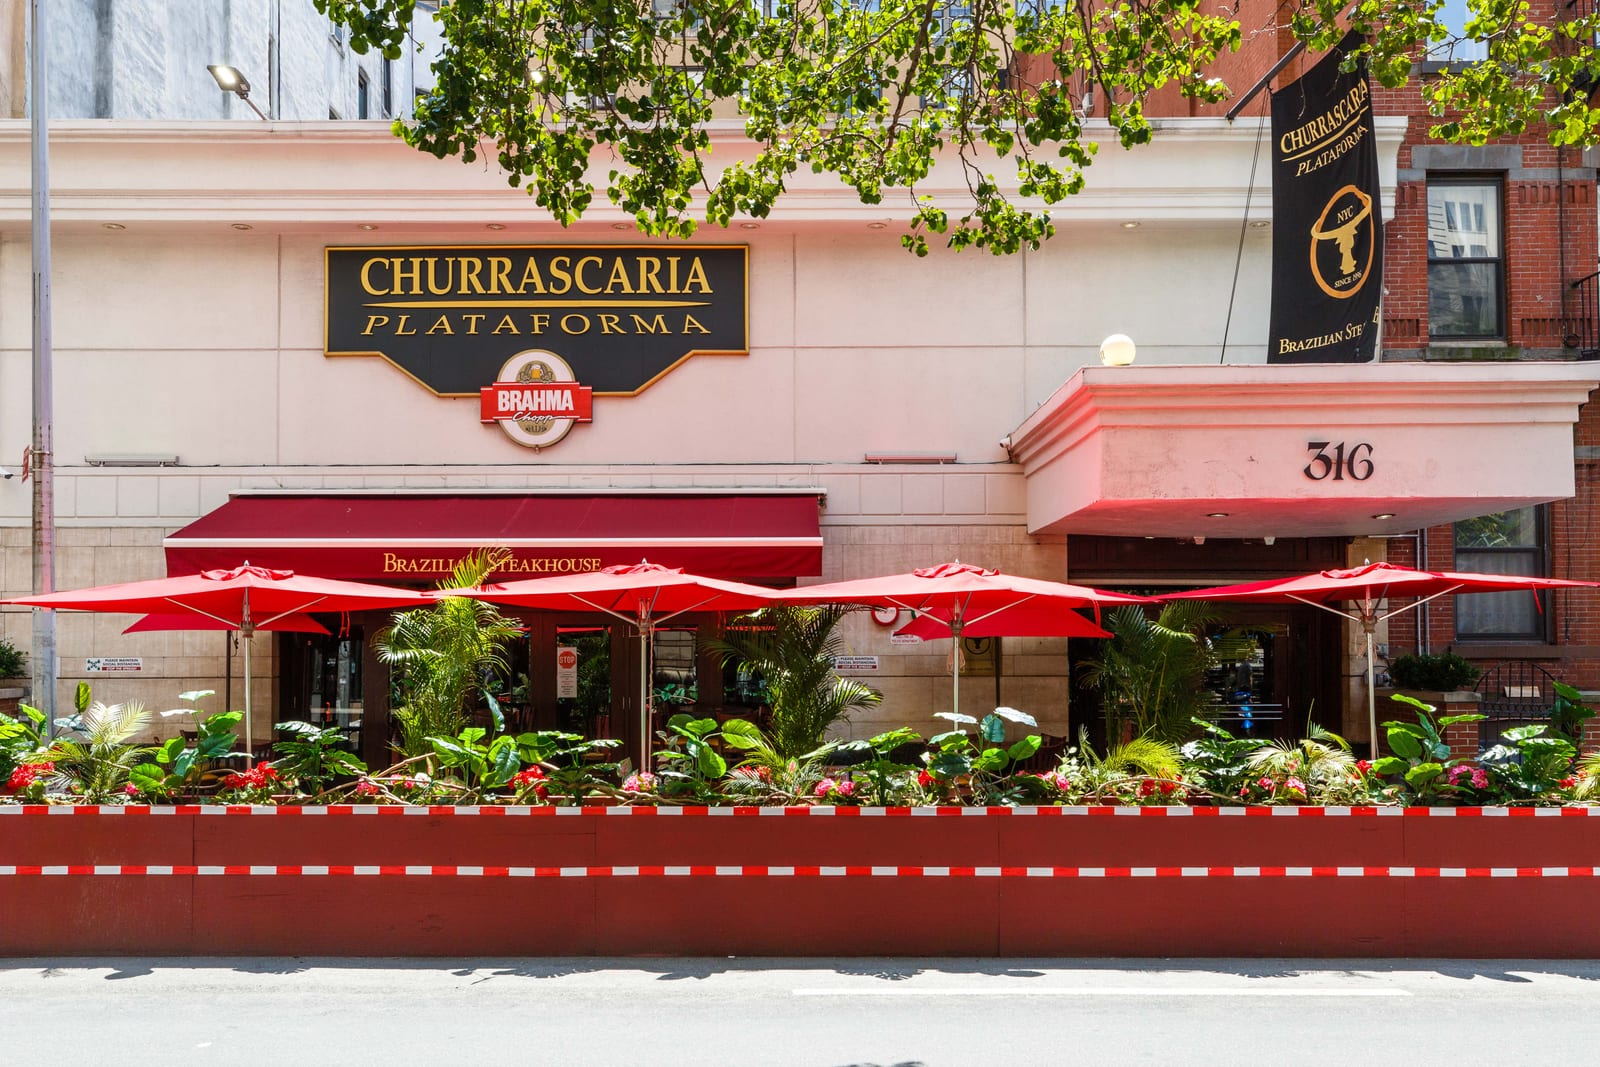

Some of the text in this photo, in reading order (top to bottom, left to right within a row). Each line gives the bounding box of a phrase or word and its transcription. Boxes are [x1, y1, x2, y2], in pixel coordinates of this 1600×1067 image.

[1337, 205, 1354, 224] NYC
[360, 256, 713, 296] CHURRASCARIA
[360, 313, 711, 335] PLATAFORMA
[498, 390, 574, 411] BRAHMA
[512, 411, 556, 424] Chopp
[1303, 441, 1374, 480] 316
[560, 656, 575, 664] STOP
